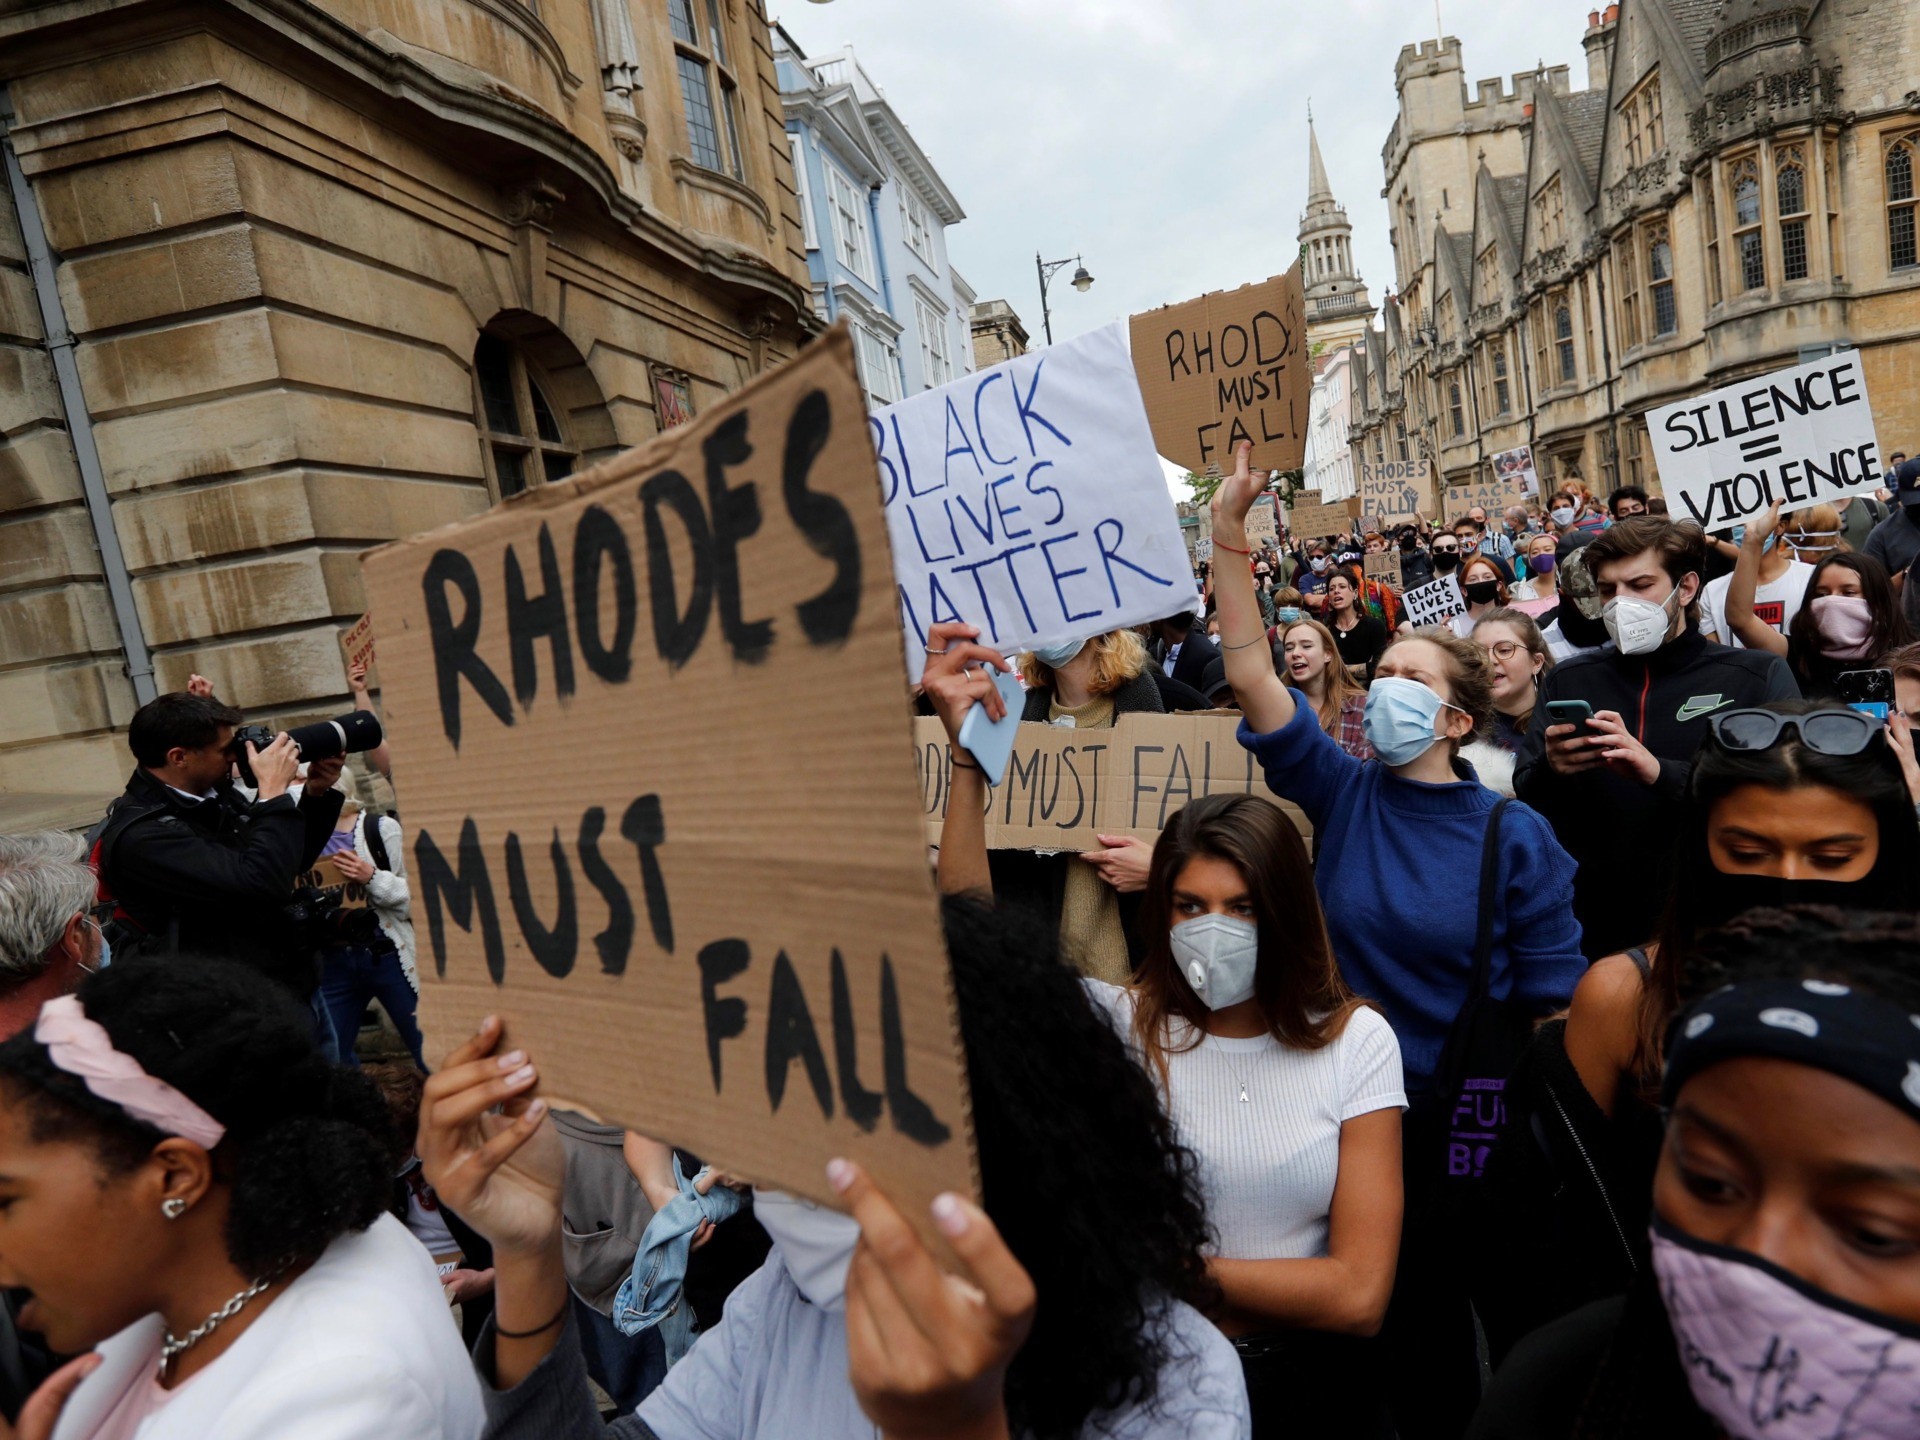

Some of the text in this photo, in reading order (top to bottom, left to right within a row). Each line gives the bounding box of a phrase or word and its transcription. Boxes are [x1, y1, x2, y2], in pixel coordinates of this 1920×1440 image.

[1218, 364, 1286, 413] MUST
[1665, 363, 1861, 453] SILENCE
[1739, 434, 1783, 462] =
[1362, 460, 1428, 482] RHODES
[1364, 480, 1406, 496] MUST
[1449, 482, 1516, 500] BLACK
[1679, 442, 1882, 528] VIOLENCE
[905, 461, 1064, 563] LIVES
[1362, 498, 1407, 517] FALL
[1469, 499, 1503, 508] LIVES
[1247, 513, 1269, 522] LIVES
[422, 389, 862, 752] RHODES
[1370, 552, 1399, 571] IT'S
[1407, 578, 1450, 605] BLACK
[1412, 591, 1454, 615] LIVES
[1005, 744, 1107, 830] MUST
[414, 793, 675, 986] MUST
[696, 937, 951, 1147] FALL
